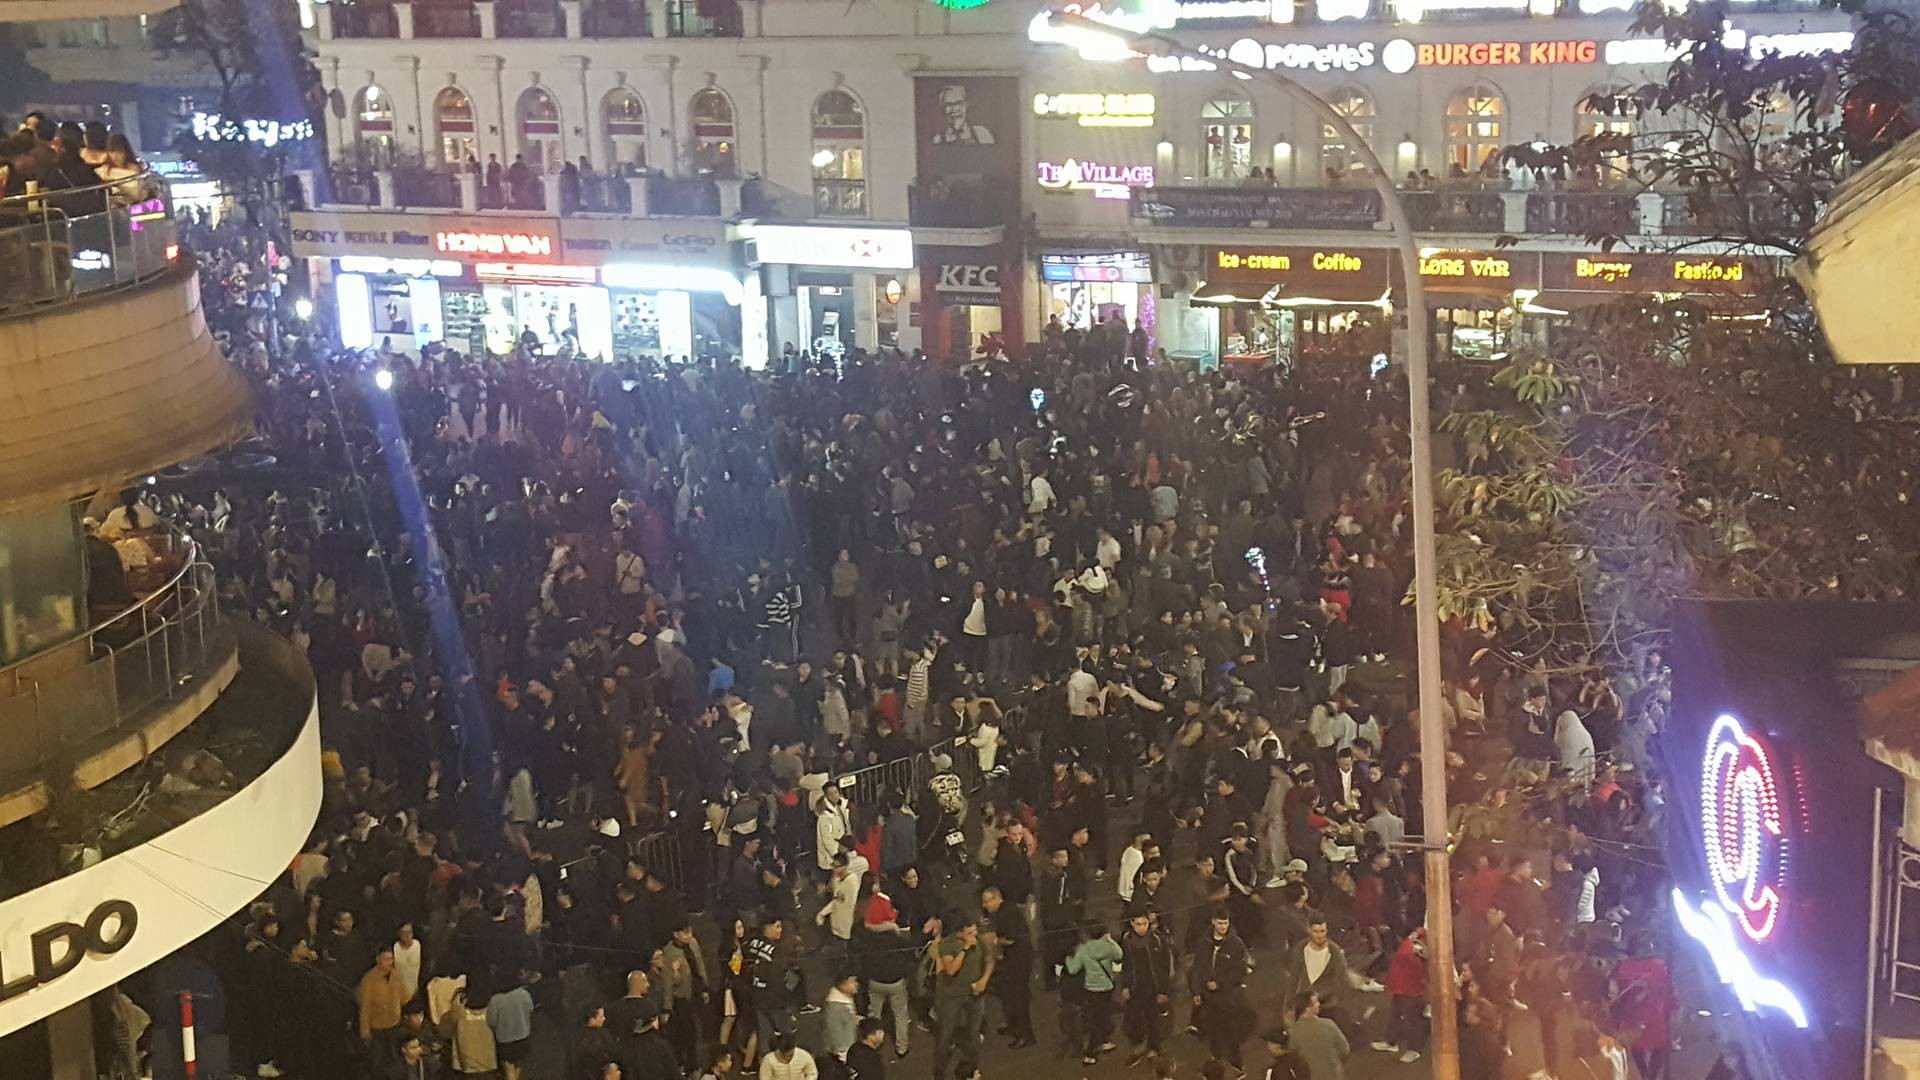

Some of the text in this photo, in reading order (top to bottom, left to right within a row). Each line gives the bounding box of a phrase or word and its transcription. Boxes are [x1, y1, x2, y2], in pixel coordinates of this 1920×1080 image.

[1417, 42, 1521, 65] BURGER
[1529, 40, 1596, 65] KING
[293, 229, 338, 243] SONY
[1312, 251, 1362, 271] Coffee
[939, 264, 999, 288] KFC
